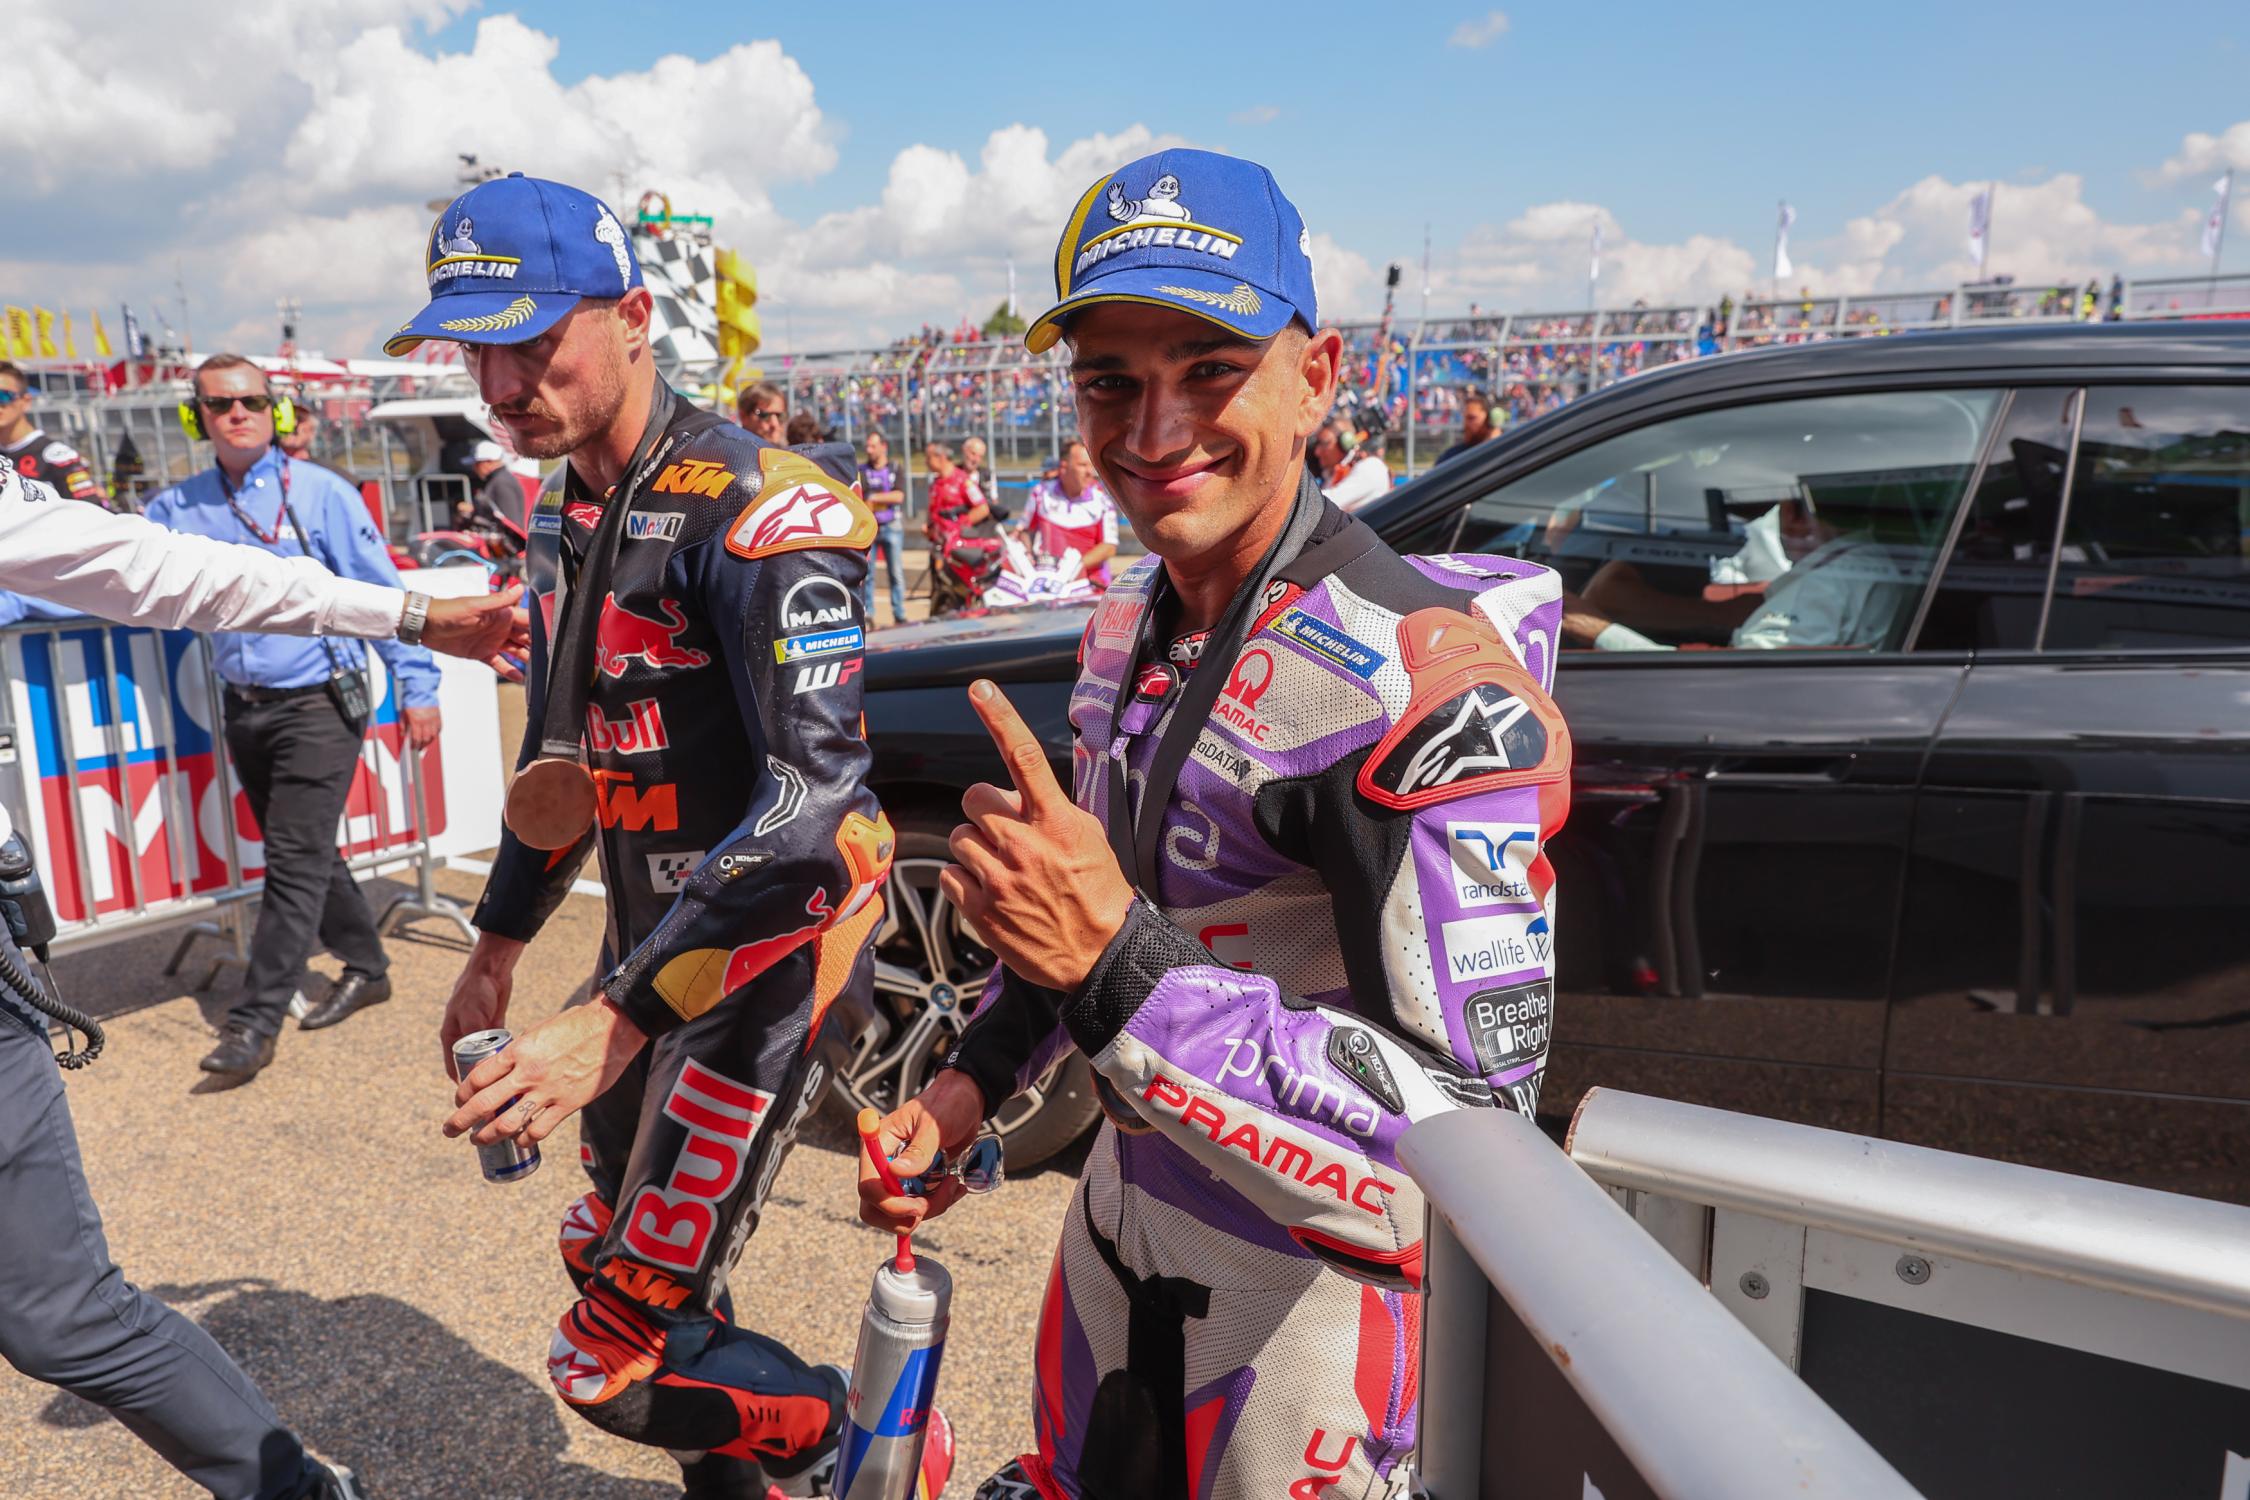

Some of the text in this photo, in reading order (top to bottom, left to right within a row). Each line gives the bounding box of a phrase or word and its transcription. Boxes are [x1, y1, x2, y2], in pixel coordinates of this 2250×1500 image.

[1076, 227, 1241, 277] MICHELIN
[652, 459, 736, 499] KTM
[789, 606, 847, 628] MAN
[1299, 627, 1371, 666] MICHELIN
[793, 658, 863, 695] WP
[588, 699, 668, 753] Bull
[1462, 880, 1531, 899] randsta
[1453, 938, 1526, 974] wallife
[1475, 992, 1548, 1029] Breathe
[1512, 1017, 1548, 1052] Right
[1215, 1038, 1379, 1138] prima
[1143, 1074, 1396, 1216] PRAMAC
[623, 1060, 773, 1270] Bull
[600, 1257, 693, 1310] KTM
